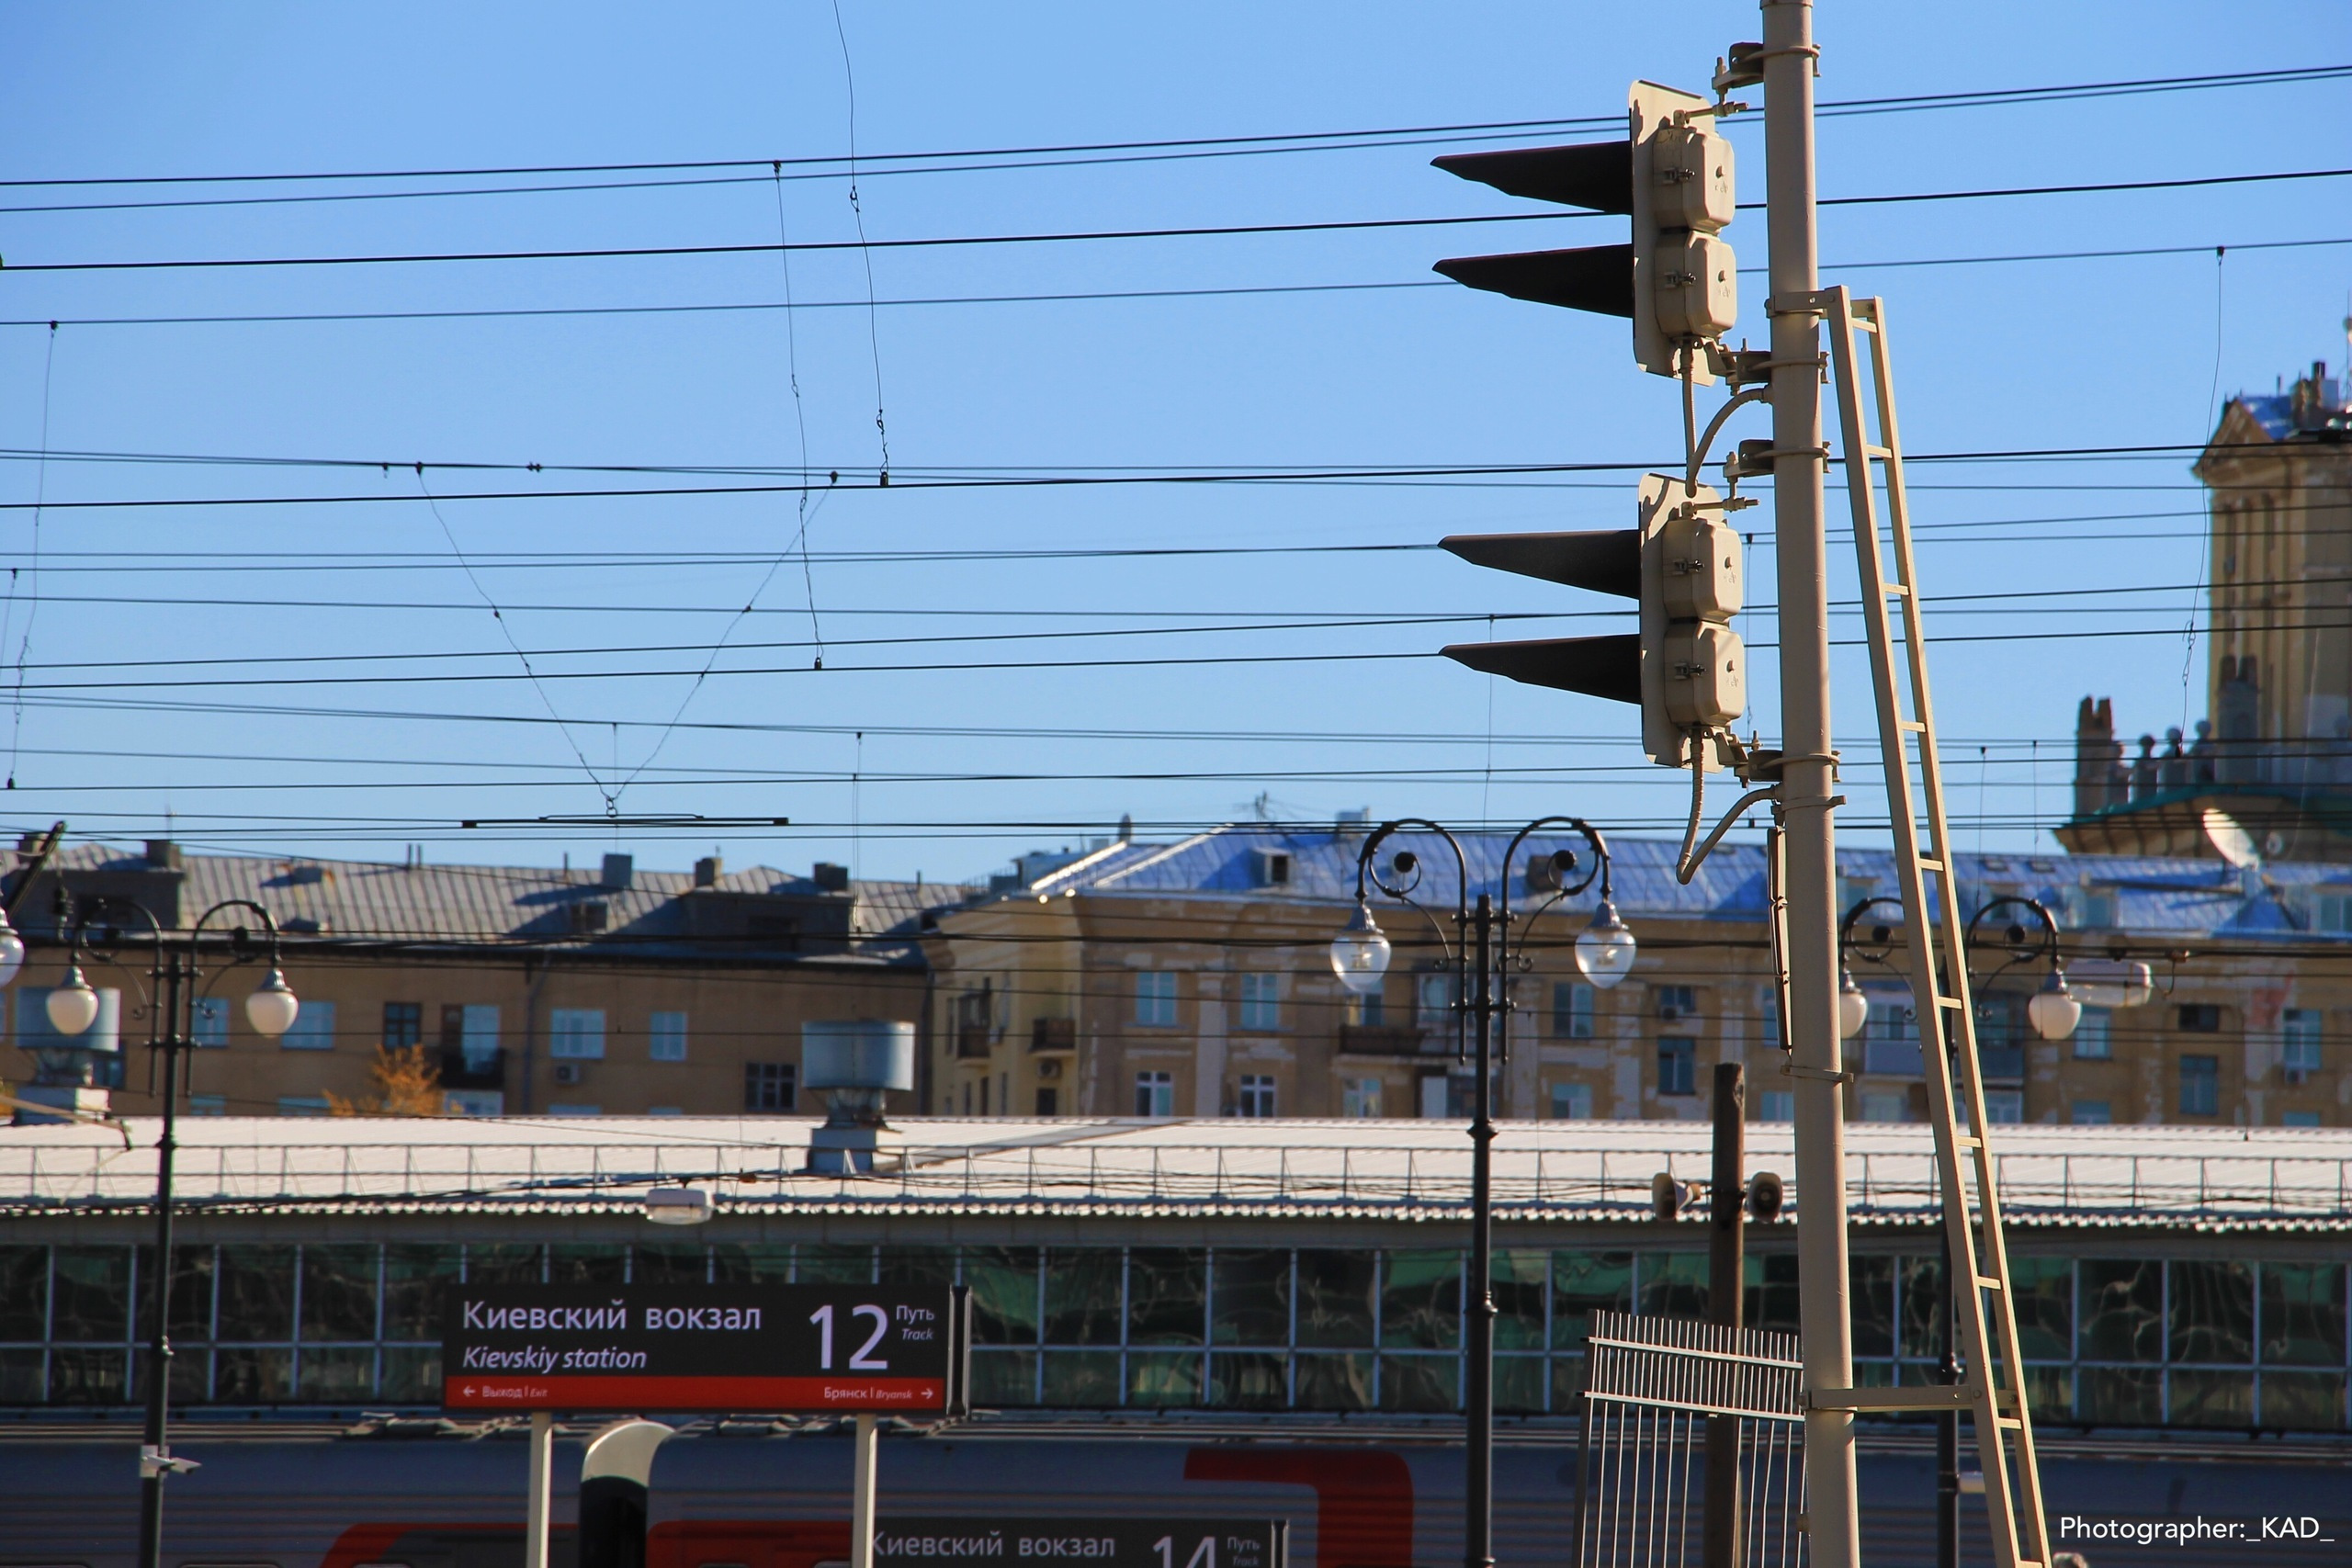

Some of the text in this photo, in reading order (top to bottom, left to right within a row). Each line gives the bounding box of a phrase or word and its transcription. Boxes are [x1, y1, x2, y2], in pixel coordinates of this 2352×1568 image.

[463, 1299, 761, 1330] Киевский вокзал
[896, 1304, 935, 1325] Путь
[809, 1303, 888, 1370] 12
[901, 1327, 933, 1341] Track
[463, 1345, 647, 1374] Kievskiy station
[823, 1386, 867, 1401] Брянск
[1018, 1537, 1115, 1557] вокзал
[1227, 1536, 1260, 1552] Путь
